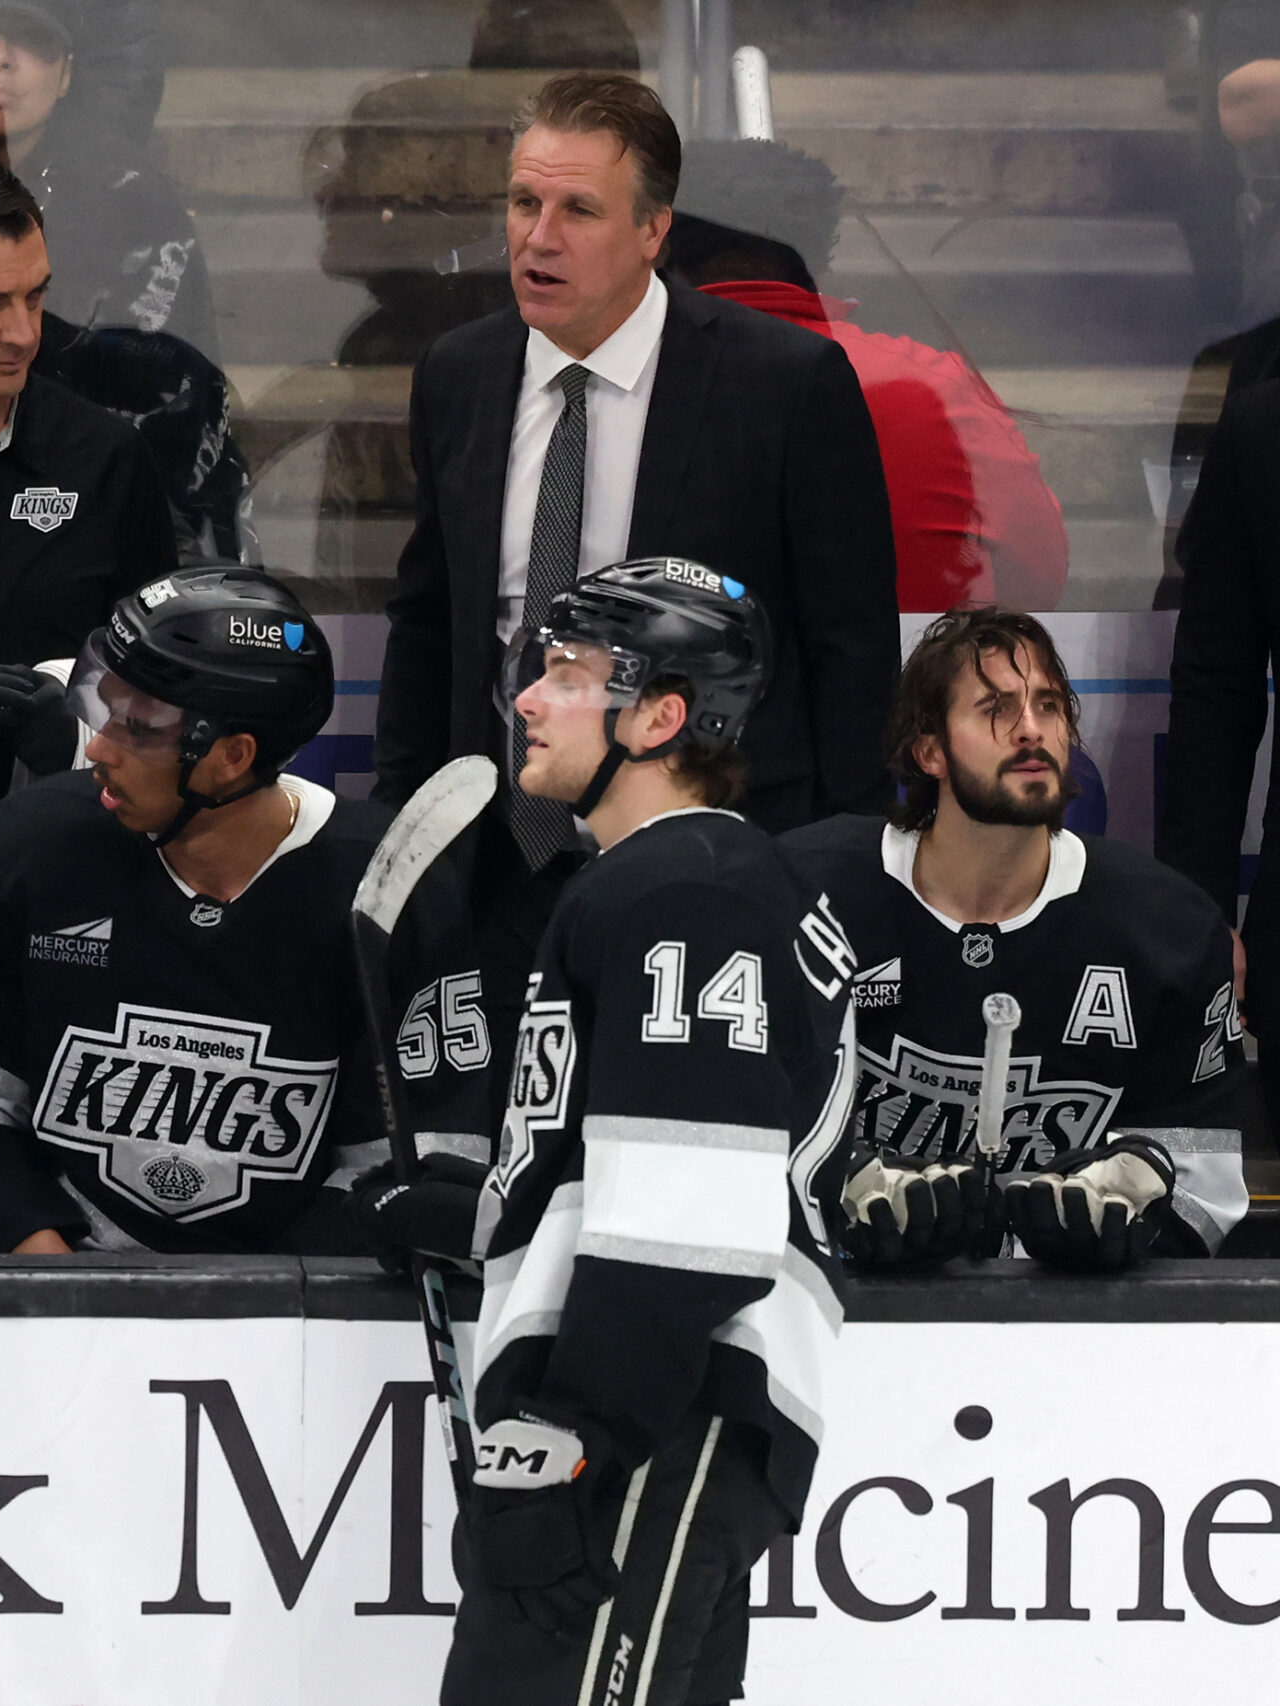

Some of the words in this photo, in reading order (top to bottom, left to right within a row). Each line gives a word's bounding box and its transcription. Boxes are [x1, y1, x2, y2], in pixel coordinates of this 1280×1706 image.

[18, 497, 72, 515] KINGS
[666, 558, 721, 588] blue
[230, 615, 282, 641] blue
[229, 638, 281, 650] CALIFORNIA
[29, 948, 109, 967] INSURANCE
[30, 934, 110, 955] MERCURY
[641, 940, 768, 1055] 14
[1062, 965, 1137, 1049] A
[396, 969, 491, 1080] 55
[137, 1029, 170, 1050] Los
[173, 1035, 246, 1060] Angeles
[908, 1064, 939, 1087] Los
[55, 1051, 318, 1159] KINGS
